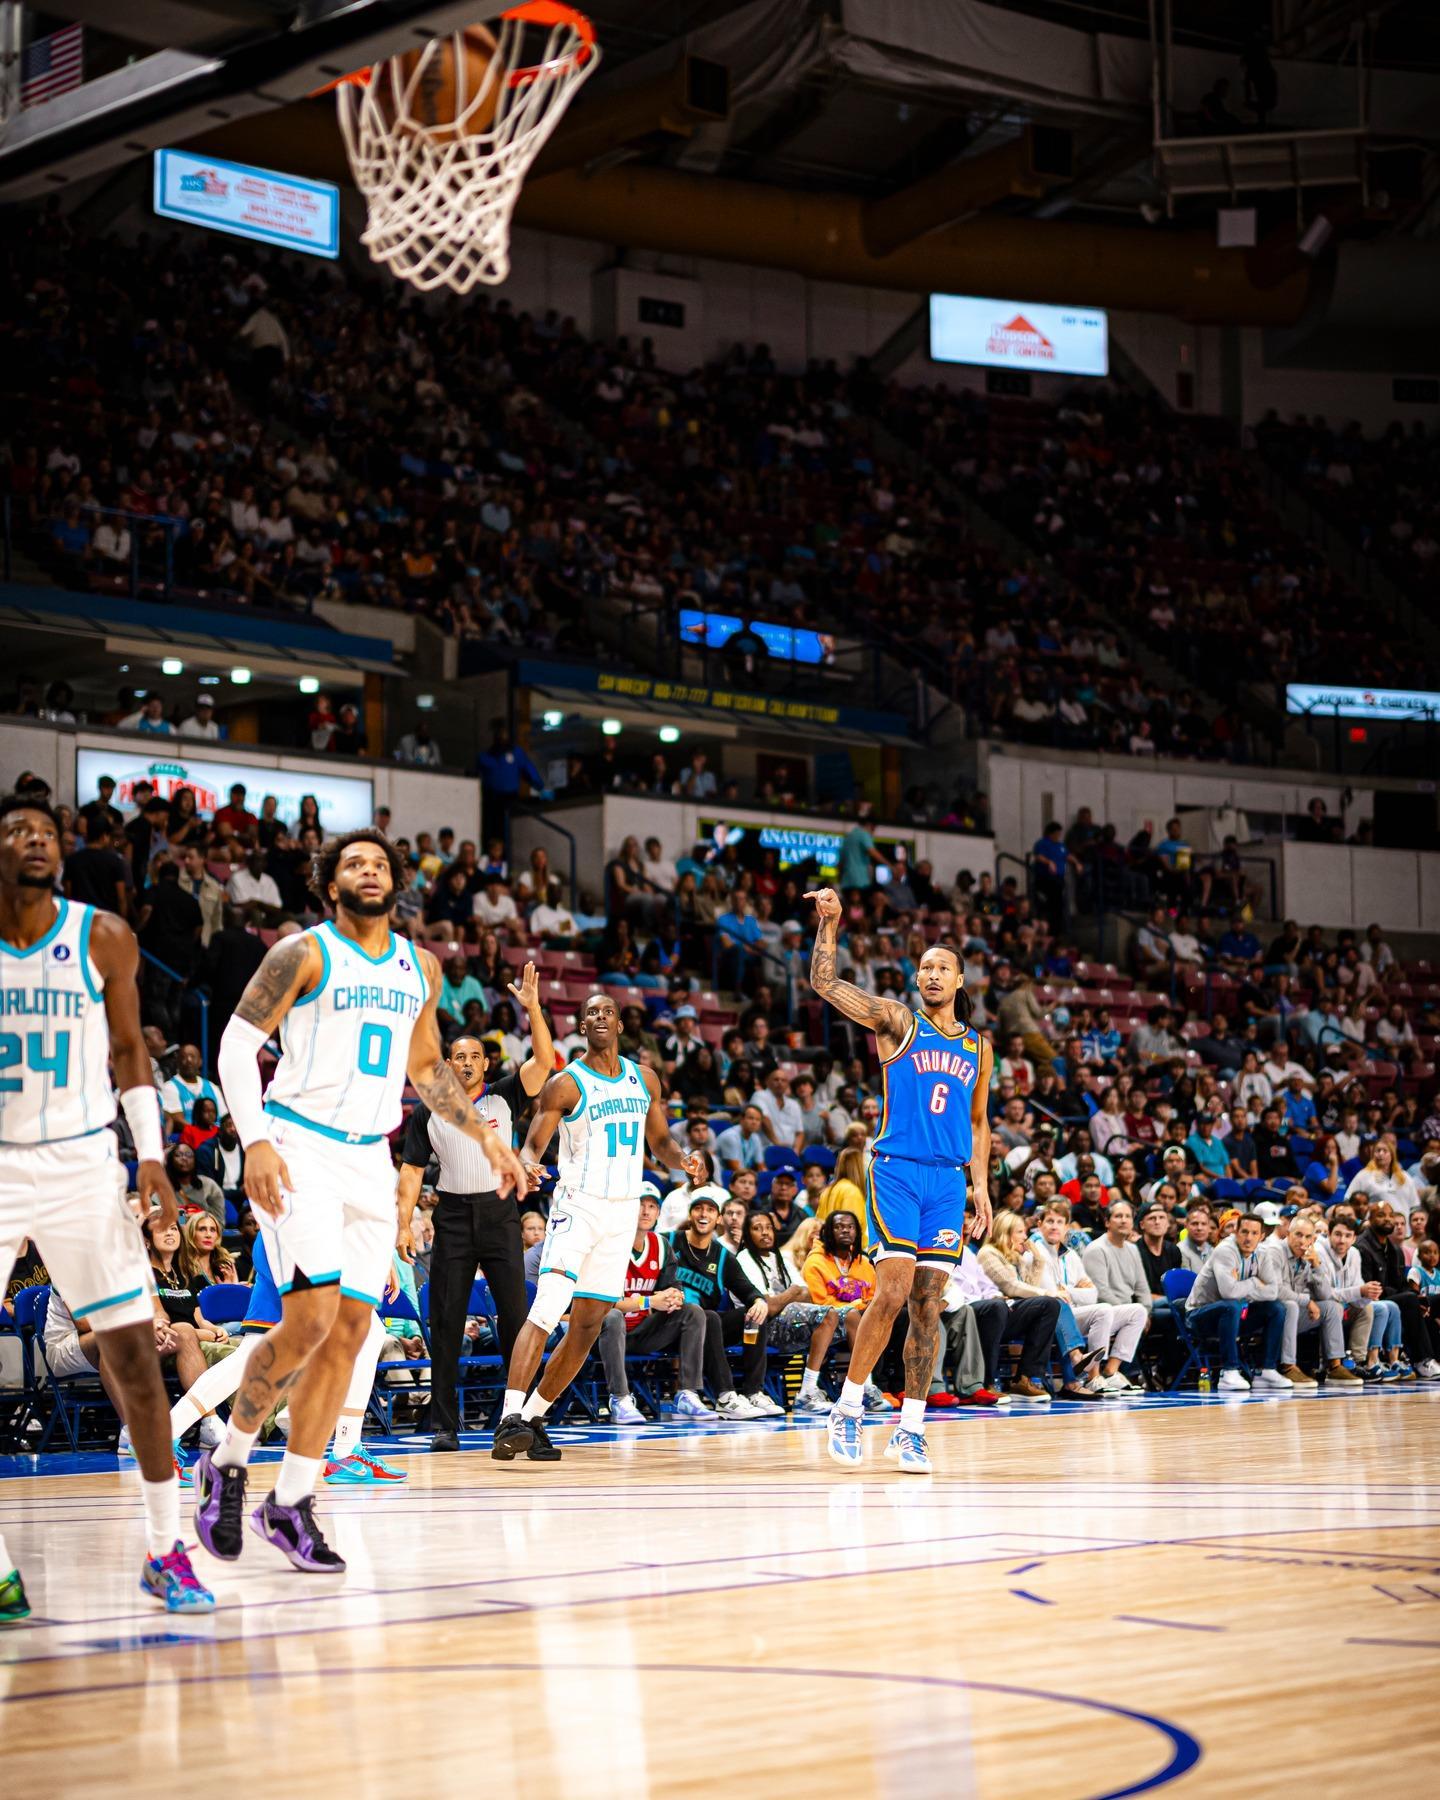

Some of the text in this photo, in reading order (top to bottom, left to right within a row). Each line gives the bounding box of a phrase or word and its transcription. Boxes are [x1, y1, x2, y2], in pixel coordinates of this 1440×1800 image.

[119, 776, 159, 803] PAA
[333, 984, 419, 1020] CHARLOTTE
[0, 1030, 70, 1092] 24
[358, 1022, 392, 1078] 0
[910, 1050, 975, 1088] THUNDER
[588, 1097, 648, 1121] CHARLOTTE
[930, 1082, 950, 1115] 6
[604, 1121, 639, 1157] 14
[624, 1277, 657, 1292] LABAM
